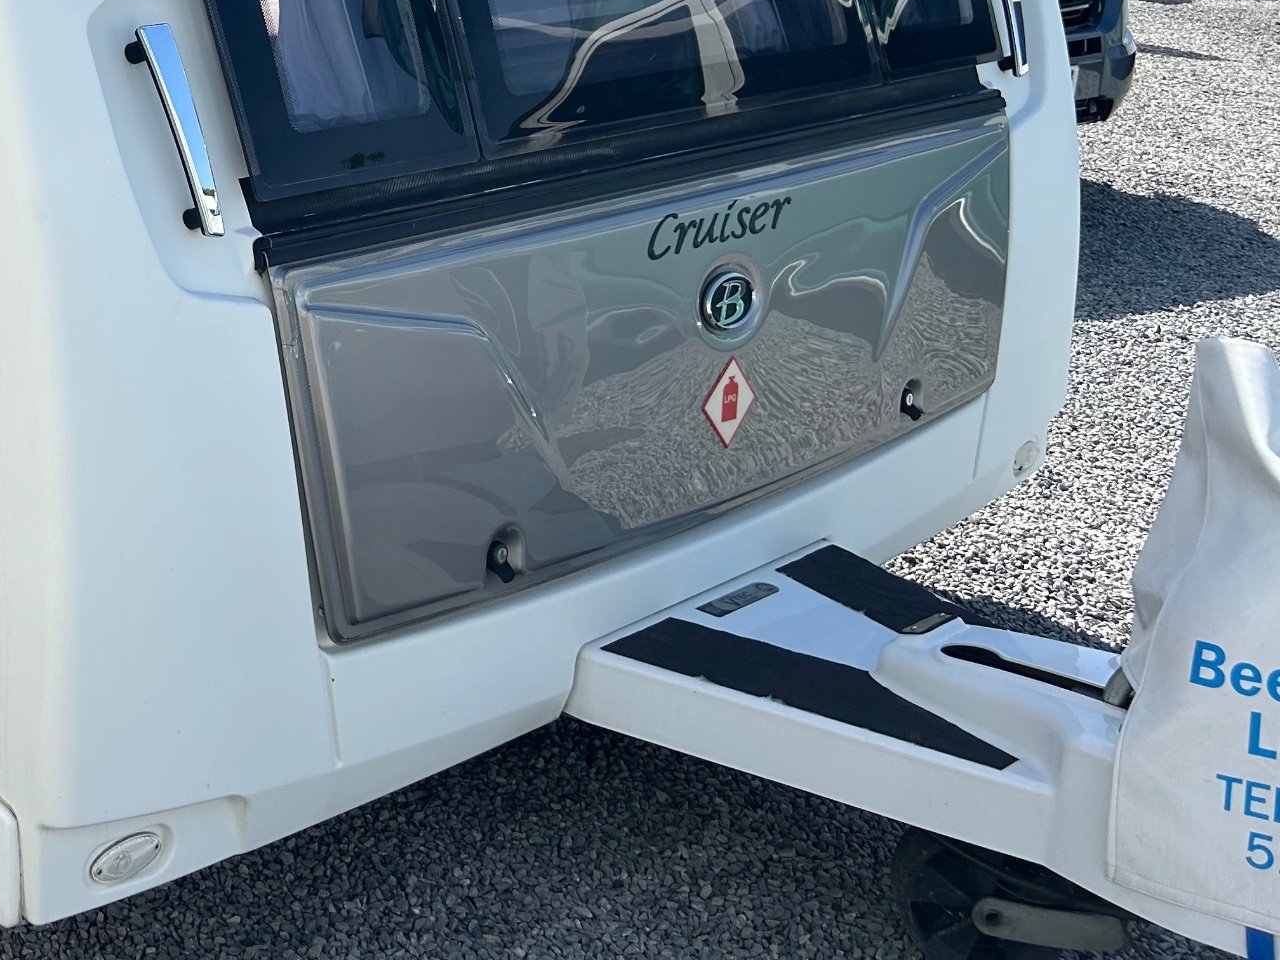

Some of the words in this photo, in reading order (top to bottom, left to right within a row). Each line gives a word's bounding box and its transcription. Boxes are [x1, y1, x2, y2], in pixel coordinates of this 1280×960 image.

[646, 196, 792, 261] Cruiser
[716, 280, 746, 326] B
[724, 393, 737, 404] LPG
[1216, 773, 1280, 825] TE
